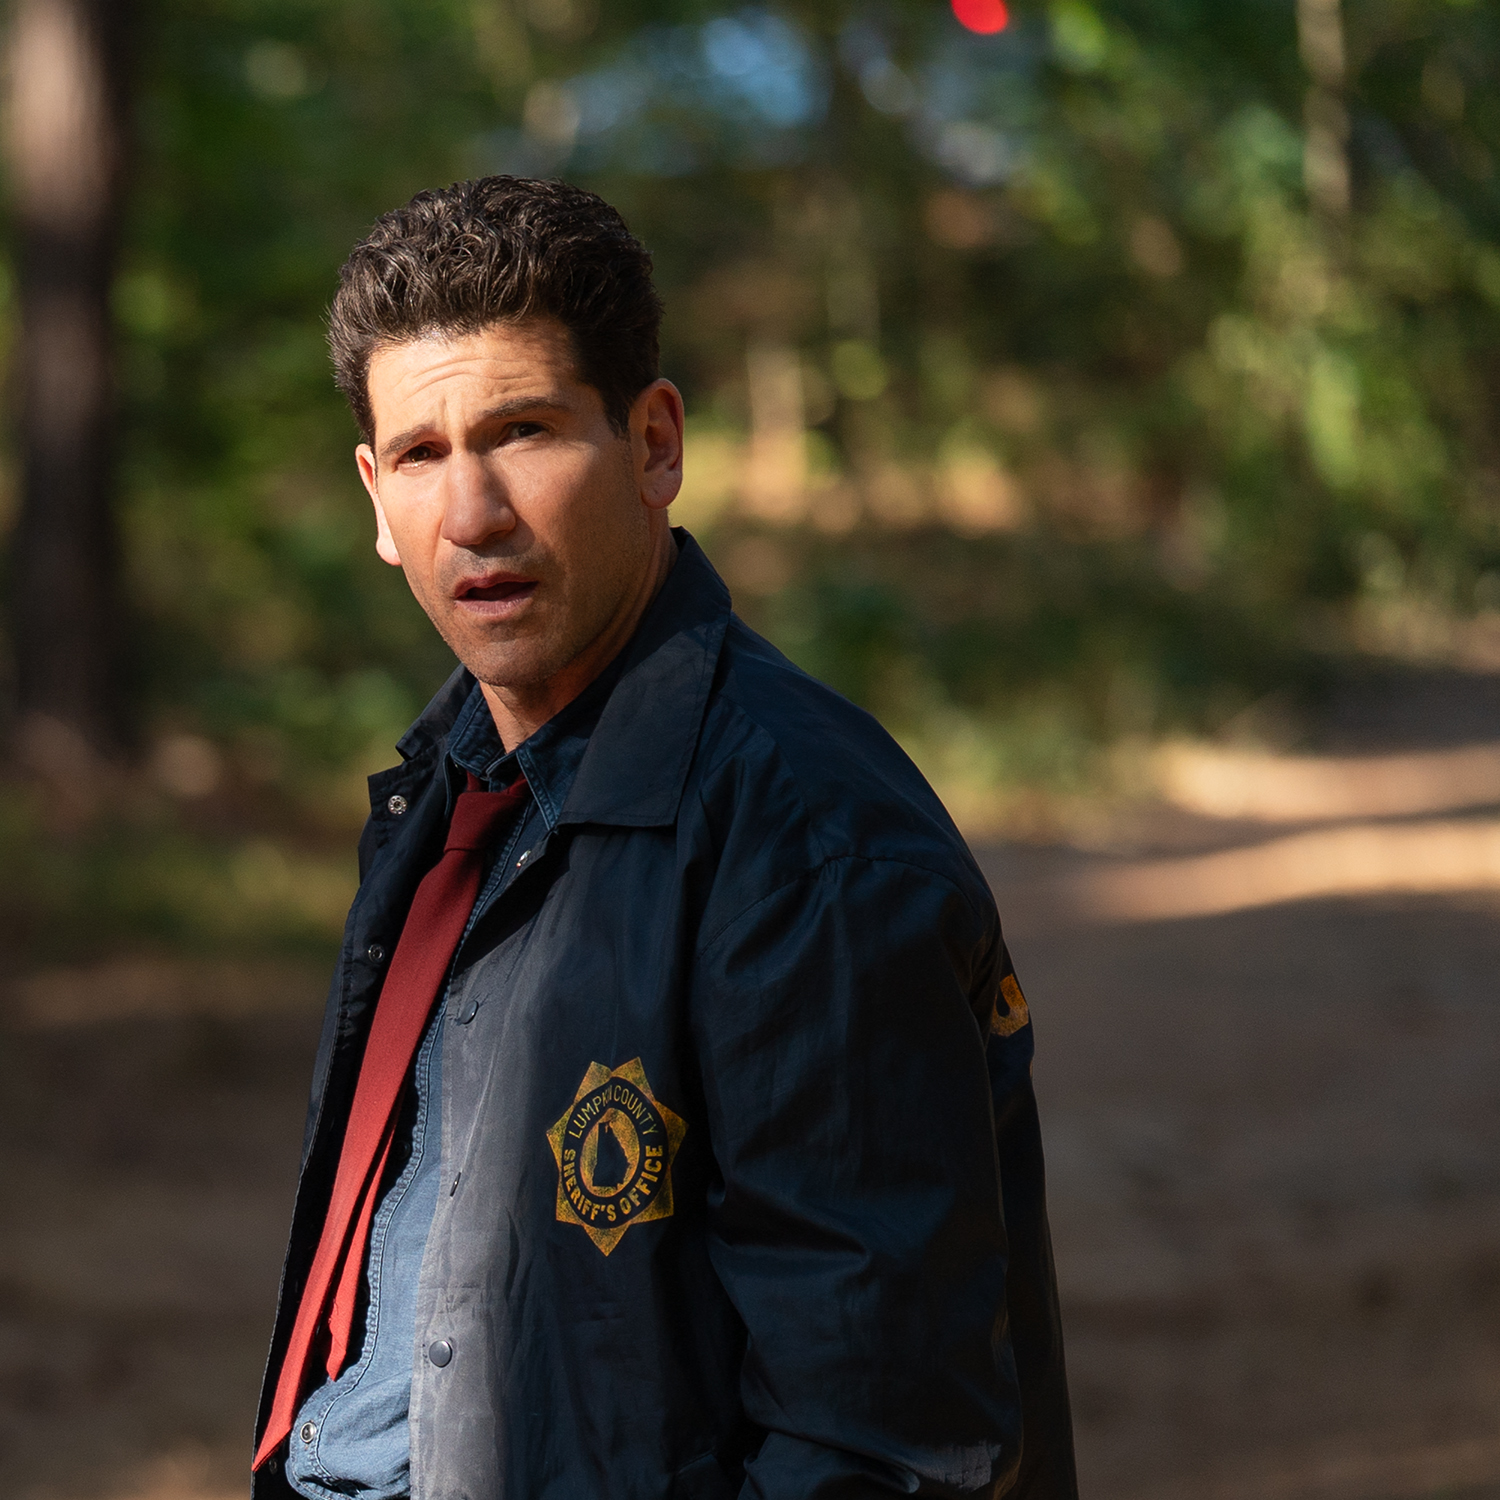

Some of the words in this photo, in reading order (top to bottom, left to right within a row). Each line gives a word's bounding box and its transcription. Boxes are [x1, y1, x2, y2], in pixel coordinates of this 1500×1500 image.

[612, 1084, 659, 1136] COUNTY
[563, 1148, 617, 1222] SHERIFF'S
[619, 1144, 663, 1215] OFFICE
